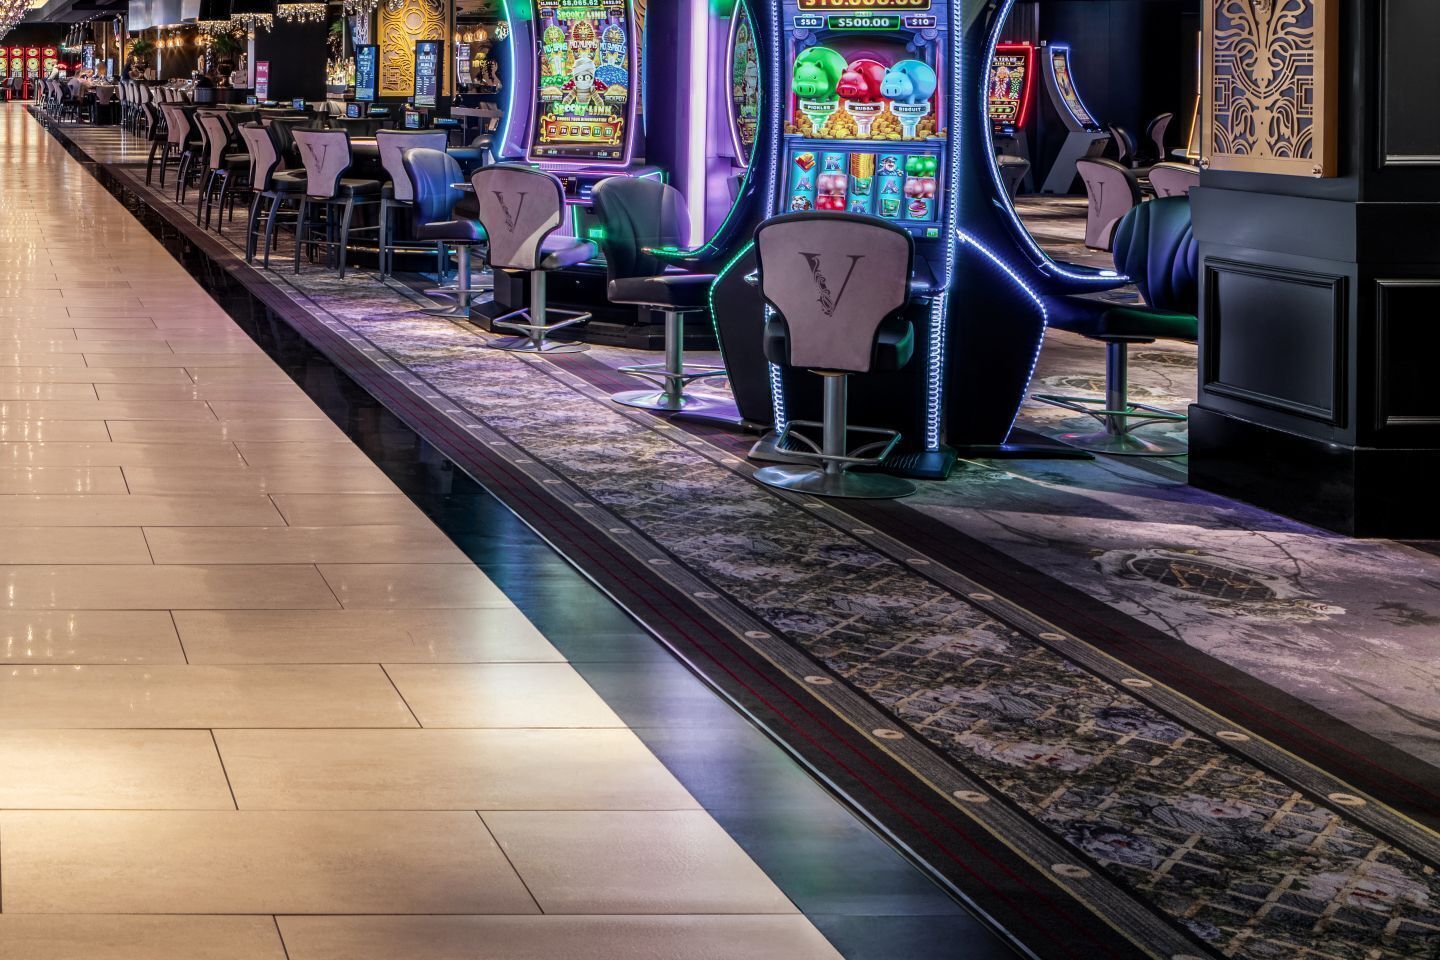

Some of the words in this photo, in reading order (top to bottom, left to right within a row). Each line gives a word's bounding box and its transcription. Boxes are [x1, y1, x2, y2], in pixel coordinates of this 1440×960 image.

[557, 10, 585, 20] SPOOKY
[586, 10, 607, 20] LINK
[838, 18, 890, 27] $500.00
[553, 102, 588, 116] SPOOKY
[588, 105, 612, 116] LINK
[492, 191, 529, 233] V
[798, 252, 866, 318] V
